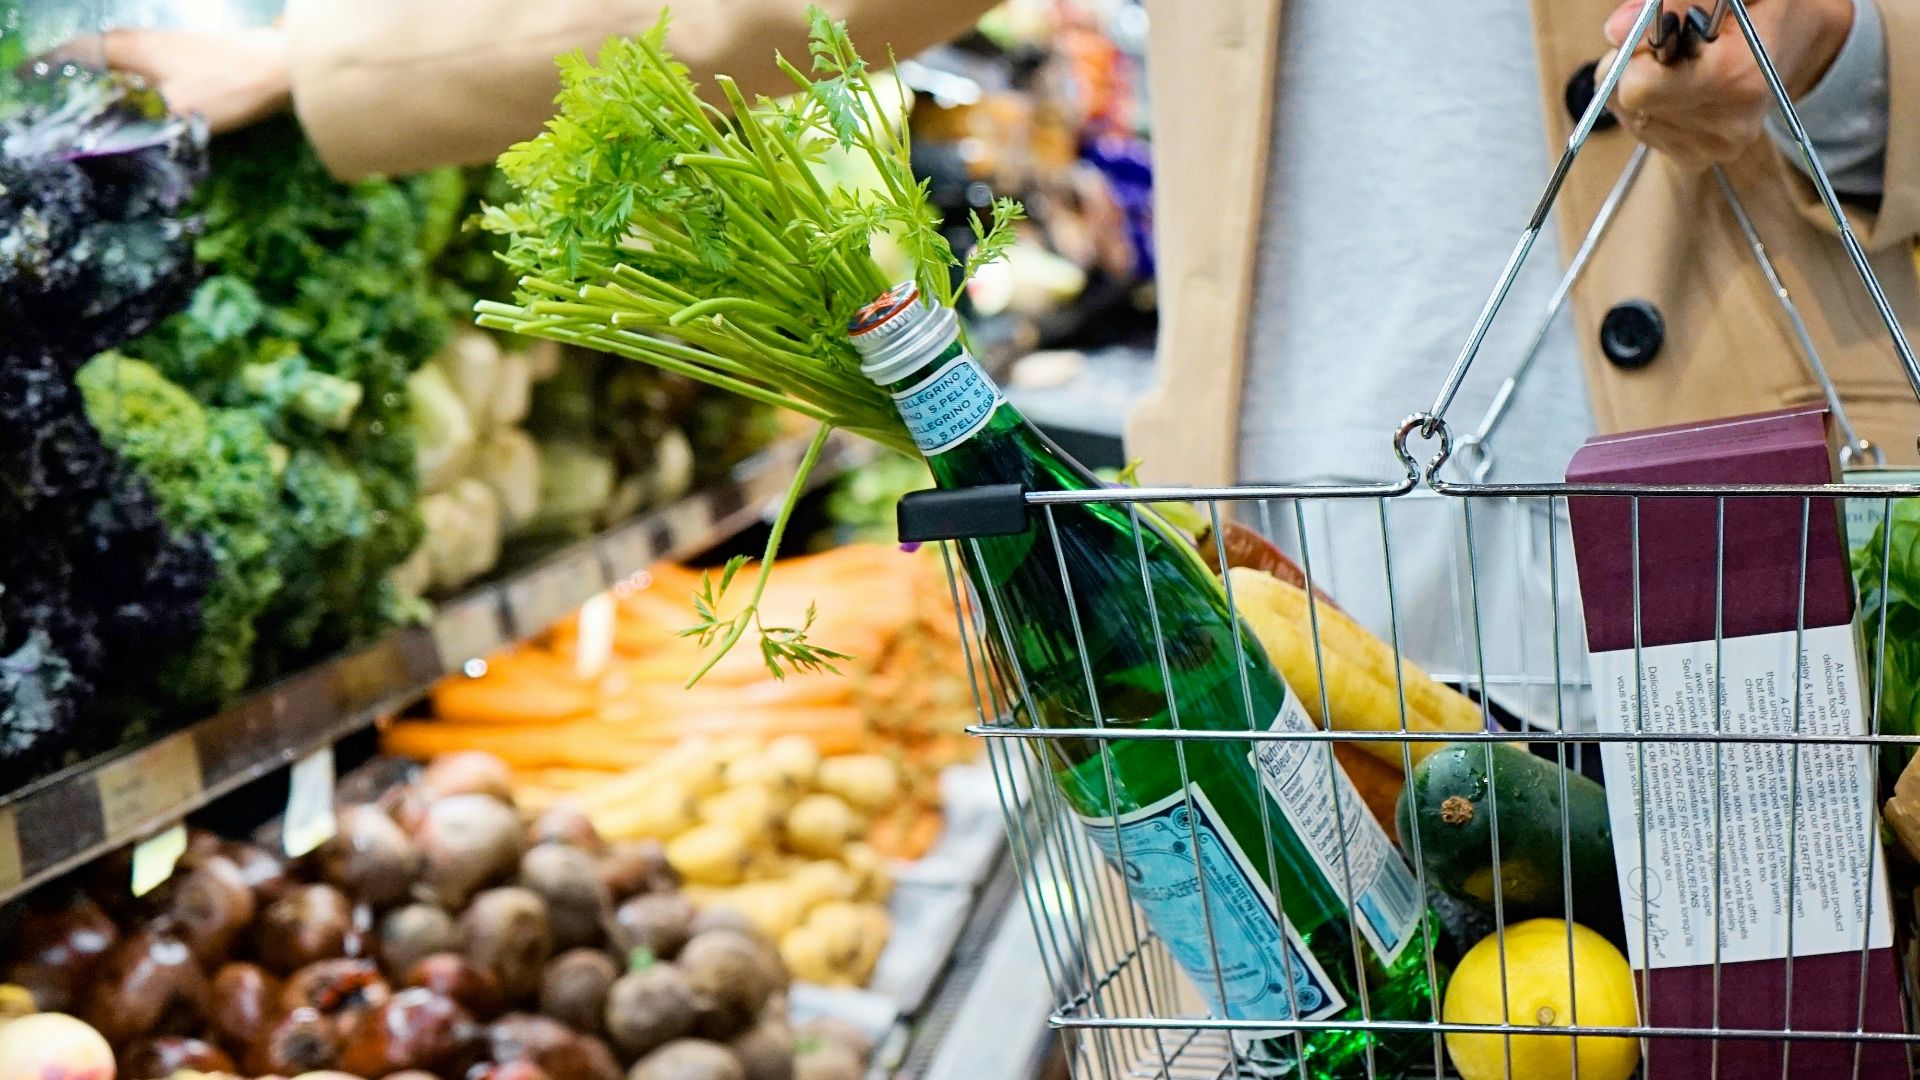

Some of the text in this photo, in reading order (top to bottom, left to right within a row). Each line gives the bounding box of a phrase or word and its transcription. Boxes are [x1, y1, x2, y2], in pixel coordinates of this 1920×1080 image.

[1681, 658, 1692, 679] Seul
[1704, 662, 1713, 674] de
[1800, 648, 1811, 680] Lesley
[1834, 662, 1843, 672] At
[1616, 675, 1625, 697] vous
[1685, 682, 1692, 693] un
[1695, 672, 1703, 693] avec
[1755, 677, 1765, 692] but
[1765, 671, 1775, 697] these
[1836, 675, 1847, 706] Lesley
[1620, 700, 1627, 712] ne
[1674, 690, 1687, 731] supérieu
[1698, 696, 1707, 718] soin,
[1757, 695, 1768, 720] really
[1779, 696, 1789, 704] A
[1805, 692, 1814, 708] her
[1685, 696, 1699, 728] produit
[1722, 709, 1731, 733] Stow
[1769, 700, 1779, 731] unique
[1808, 710, 1817, 734] team
[1818, 705, 1826, 721] are
[1701, 721, 1709, 733] en
[1761, 722, 1771, 747] she
[1259, 740, 1285, 765] Nutri
[1625, 752, 1637, 771] plus
[1648, 750, 1657, 763] de
[1680, 742, 1694, 776] pouvait
[1704, 742, 1714, 766] etites
[1774, 736, 1785, 773] ackers
[1812, 742, 1822, 760] ink
[1824, 752, 1835, 771] with
[1266, 750, 1292, 779] Valeur
[1765, 750, 1775, 775] when
[1802, 750, 1814, 784] scratch
[1815, 762, 1824, 777] the
[1650, 765, 1663, 812] trempette,
[1696, 767, 1710, 804] fabriqué
[1729, 763, 1740, 792] Foods
[1746, 775, 1754, 790] are
[1779, 775, 1787, 791] are
[1822, 653, 1864, 922] delicious food. The fabulous crisps from Lesley's kitchen
[1827, 773, 1836, 794] care
[1847, 763, 1859, 793] Foods
[1687, 778, 1699, 819] satisfaire
[1744, 678, 1782, 915] cheese or We are addicted to this yummy
[1768, 777, 1781, 809] topped
[1807, 786, 1816, 811] using
[1816, 780, 1827, 799] only
[1830, 796, 1838, 805] in
[1647, 665, 1693, 947] Délicieux au ces craquelins sont irrésistibles lorsqu'ils
[1663, 704, 1700, 908] CRAEZ POUR CES FINS CRAQUELINS
[1721, 784, 1732, 822] fabuleux
[1733, 795, 1743, 821] adore
[1748, 793, 1757, 813] sure
[1780, 793, 1793, 817] great
[1819, 801, 1828, 820] way
[1852, 795, 1859, 809] we
[1657, 814, 1666, 826] de
[1702, 807, 1711, 829] avec
[1749, 816, 1760, 833] you
[1773, 812, 1784, 831] with
[1810, 814, 1818, 829] our
[1822, 822, 1831, 831] to
[1832, 808, 1843, 832] small
[1854, 811, 1862, 831] love
[1659, 828, 1670, 866] fromage
[1693, 822, 1704, 851] Lesley
[1705, 831, 1714, 848] des
[1737, 824, 1748, 864] fabriquer
[1754, 836, 1764, 849] will
[1774, 833, 1785, 852] your
[1812, 831, 1823, 856] finest
[1824, 833, 1835, 859] make
[1697, 854, 1706, 863] et
[1726, 825, 1739, 872] craquelins
[1756, 852, 1765, 864] be
[1835, 835, 1847, 873] batches.
[1857, 834, 1867, 867] making
[1665, 869, 1672, 880] ou
[1699, 865, 1707, 882] son
[1743, 867, 1751, 876] et
[1758, 866, 1767, 883] too.
[1826, 870, 1839, 894] great
[1723, 887, 1732, 899] de
[1733, 875, 1743, 894] sont
[1744, 879, 1753, 900] vous
[1793, 876, 1803, 895] their
[1815, 858, 1830, 910] ingredients.
[1736, 897, 1749, 940] fabriqués
[1747, 903, 1757, 923] offrir
[1796, 898, 1804, 918] own
[1830, 896, 1844, 932] product
